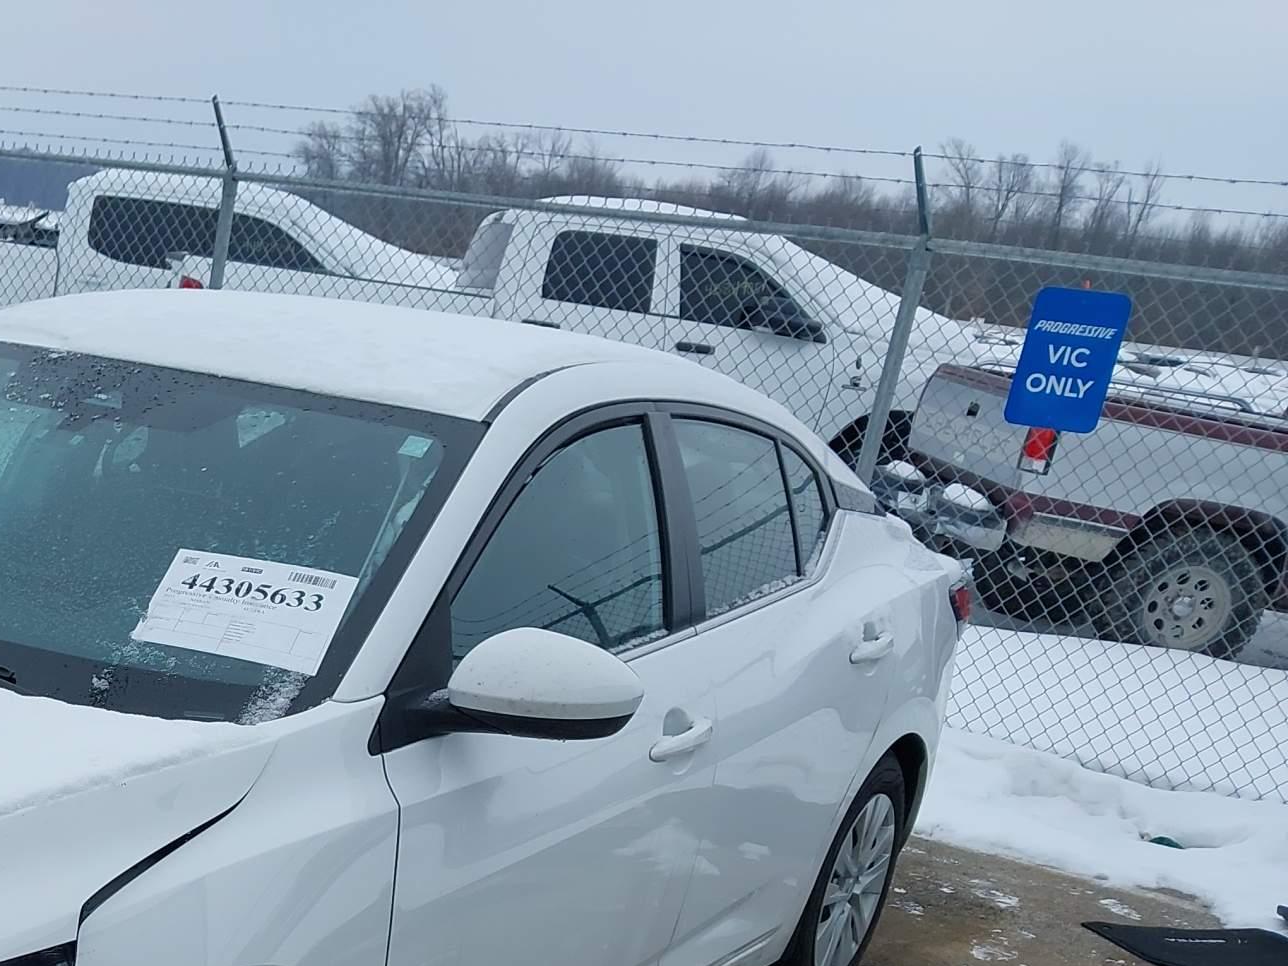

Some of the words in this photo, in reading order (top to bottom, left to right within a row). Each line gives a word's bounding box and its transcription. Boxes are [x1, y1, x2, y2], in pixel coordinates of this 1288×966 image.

[1033, 319, 1118, 339] PROGRESSIVE
[1048, 344, 1091, 368] VIC
[1025, 373, 1095, 398] ONLY
[181, 573, 325, 613] 44305633
